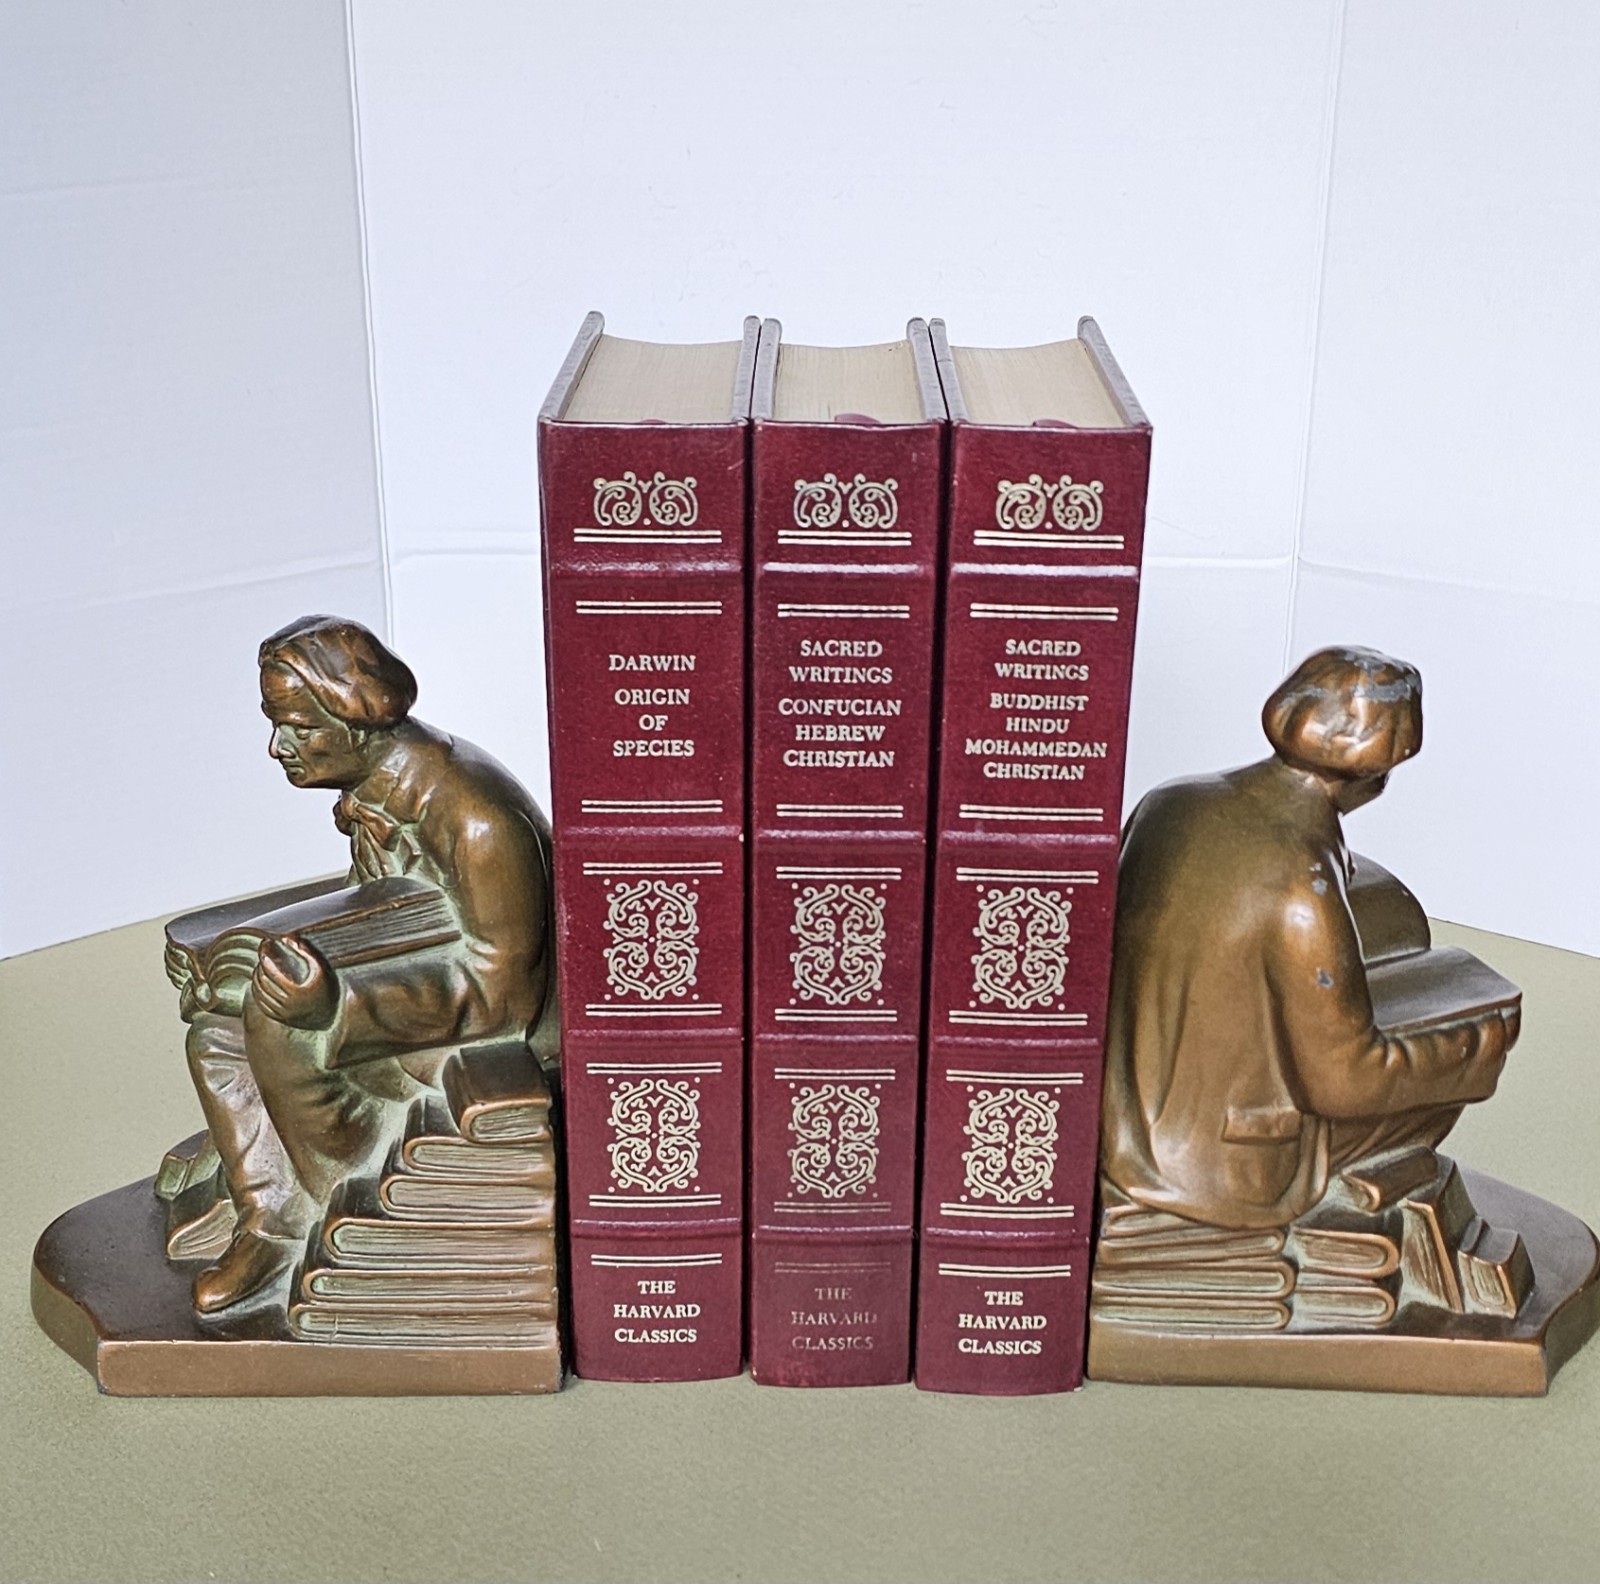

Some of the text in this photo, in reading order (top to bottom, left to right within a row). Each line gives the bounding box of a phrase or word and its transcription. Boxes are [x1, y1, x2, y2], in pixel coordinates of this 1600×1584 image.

[800, 639, 883, 658] SACRED
[1005, 638, 1082, 657] SACRED
[608, 654, 697, 672] DARWIN
[994, 662, 1090, 681] WRITINGS
[788, 665, 893, 684] WRITINGS
[614, 688, 691, 706] ORIGIN
[989, 692, 1090, 712] BUDDHIST
[778, 697, 902, 717] CONFUCIAN
[638, 714, 669, 732] OF
[1005, 716, 1070, 734] HINDU
[795, 724, 886, 742] HEBREW
[612, 739, 695, 757] SPECIES
[964, 738, 1108, 758] MOHAMMEDAN
[782, 749, 895, 768] CHRISTIAN
[983, 761, 1086, 781] CHRISTIAN
[636, 1279, 677, 1295] THE
[814, 1287, 852, 1301] THE
[983, 1290, 1024, 1306] THE
[613, 1303, 701, 1319] HARVARD
[957, 1313, 1048, 1331] HARVARD
[614, 1327, 698, 1344] CLASSICS
[791, 1335, 874, 1351] CLASSICS
[957, 1337, 1042, 1356] CLASSICS
